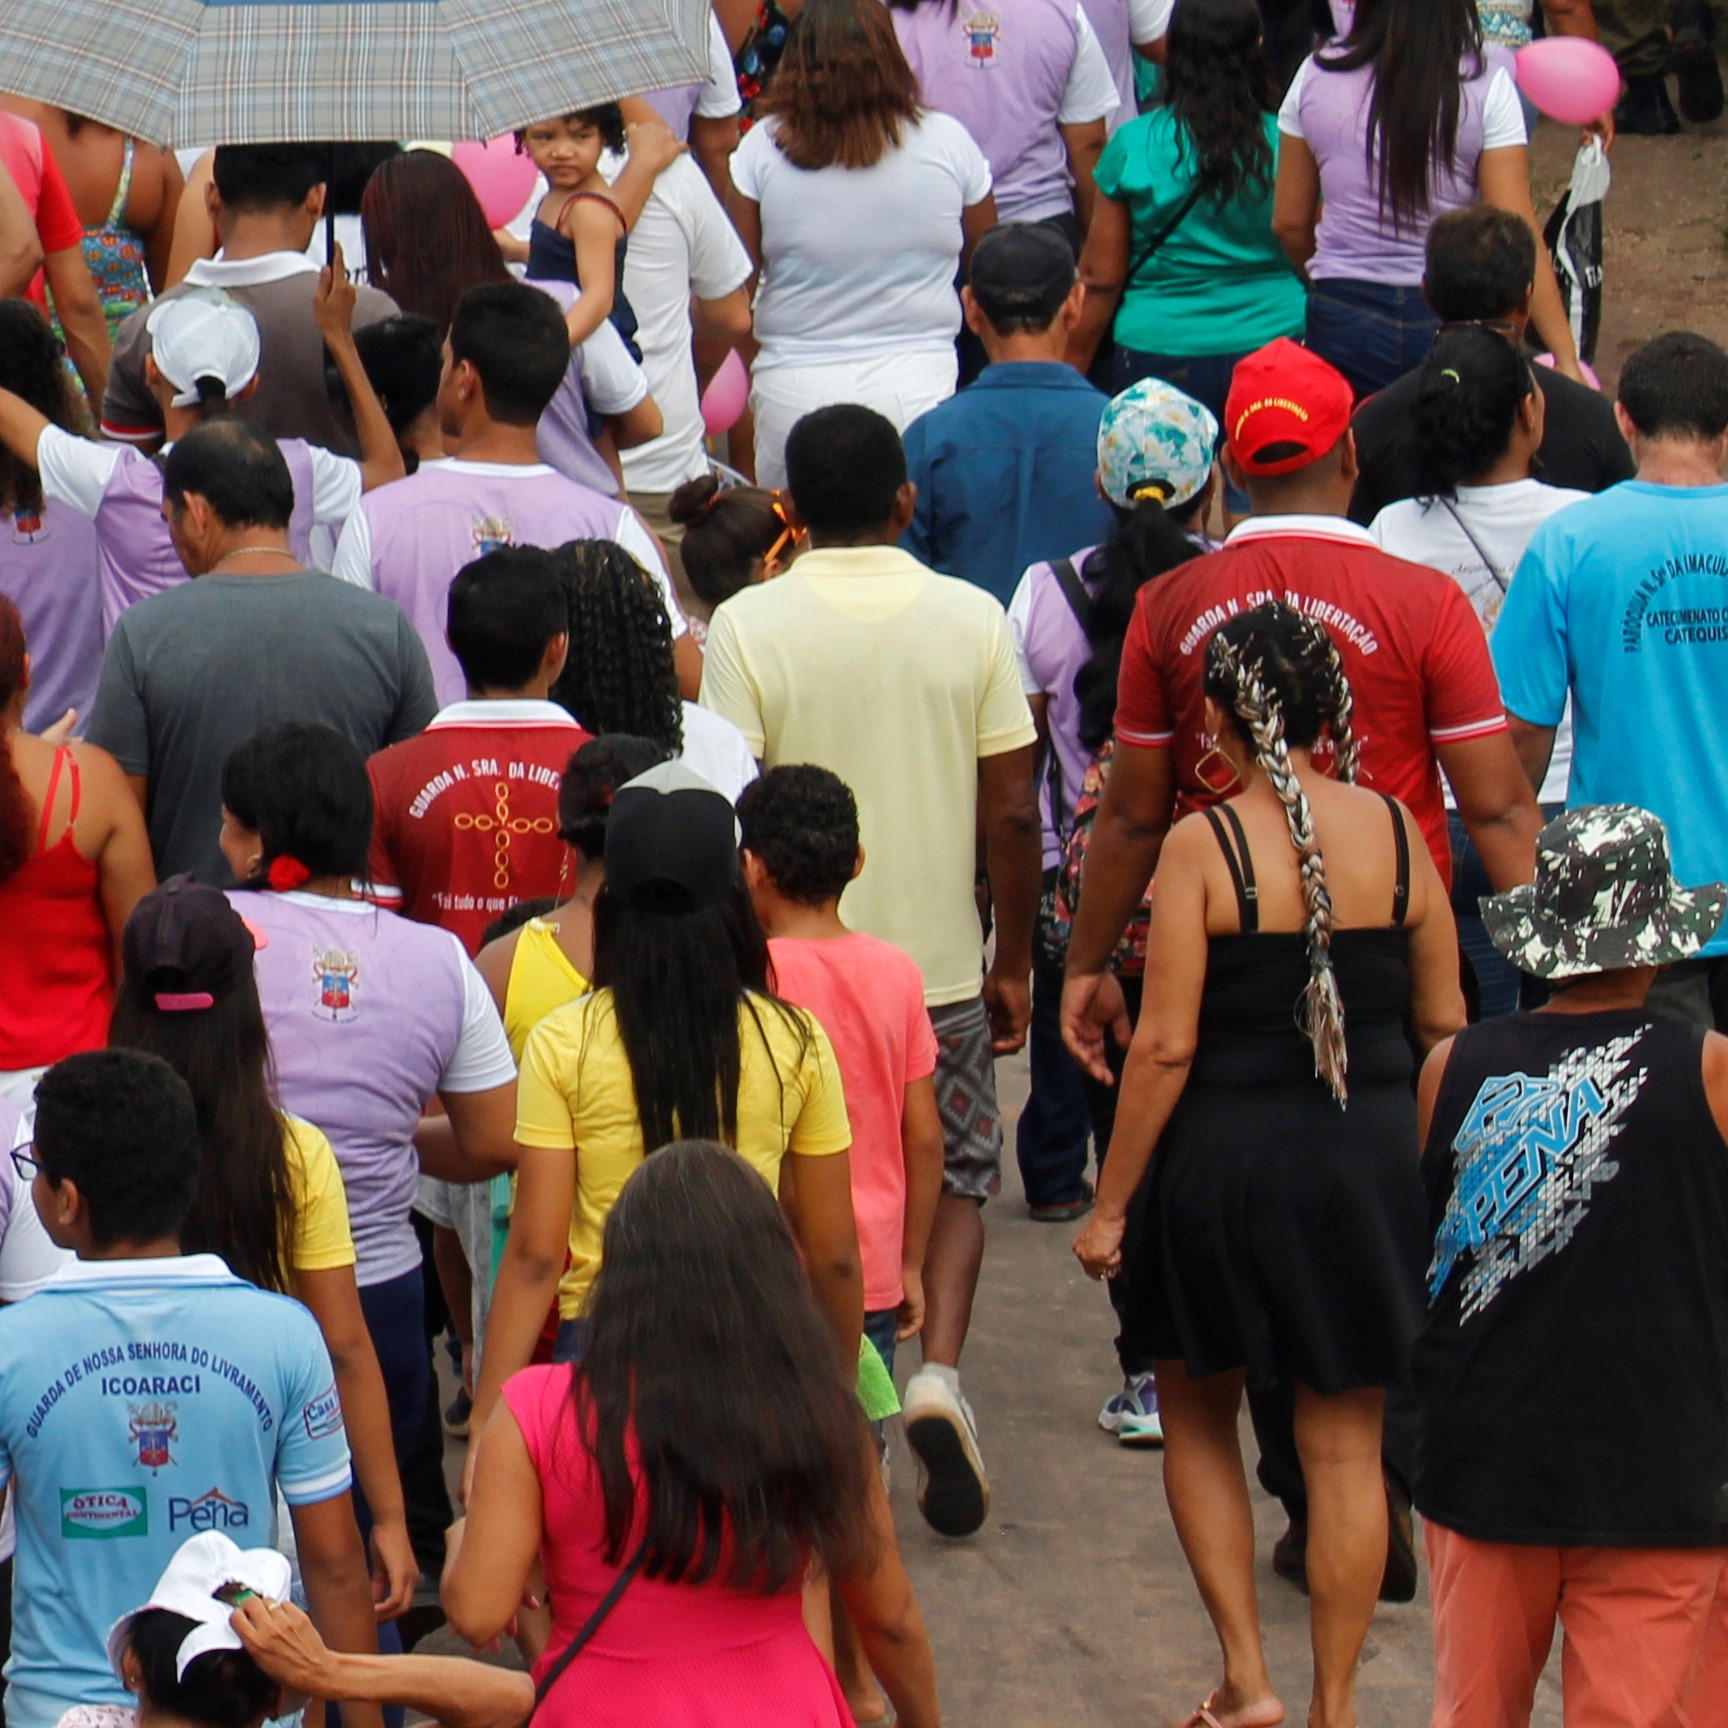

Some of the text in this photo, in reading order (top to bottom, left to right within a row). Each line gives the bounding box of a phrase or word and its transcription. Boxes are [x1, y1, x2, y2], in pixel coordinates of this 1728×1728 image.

[1179, 604, 1227, 656] GUARDA
[1303, 596, 1380, 656] LIBERTAÇÃO
[409, 770, 455, 820] GUARDA
[471, 758, 502, 777] SRA.
[508, 761, 525, 780] DA
[26, 1341, 274, 1440] GUARDA DE NOSSA SENHORA DO LIVRAMENTO
[101, 1374, 201, 1396] ICOARACI
